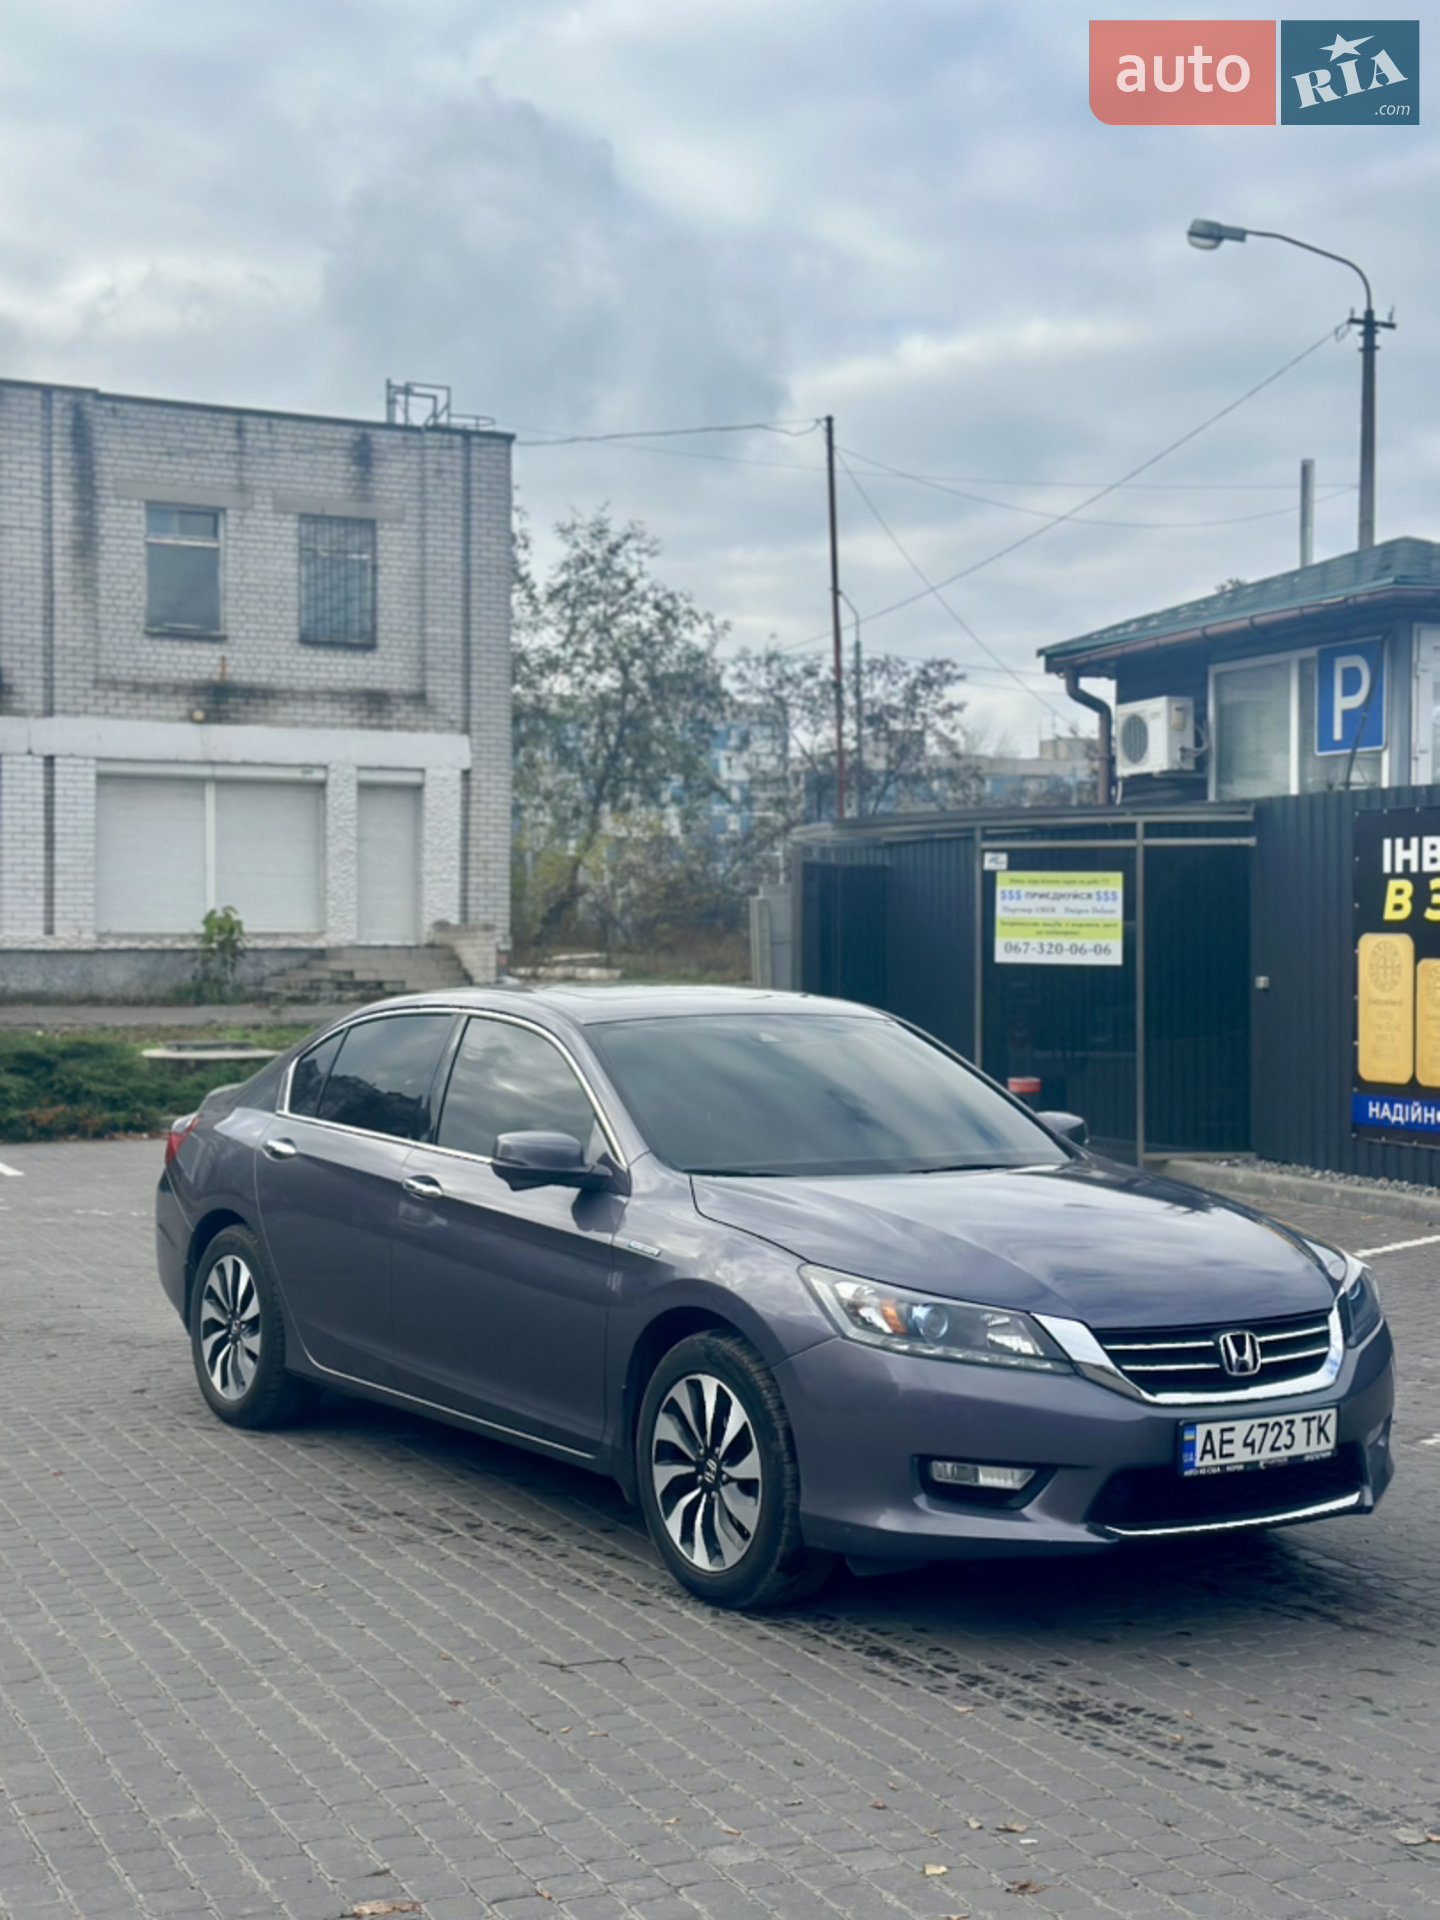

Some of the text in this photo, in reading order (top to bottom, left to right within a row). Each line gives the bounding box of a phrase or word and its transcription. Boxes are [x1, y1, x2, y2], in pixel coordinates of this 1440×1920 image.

[1333, 654, 1371, 742] P
[1383, 879, 1413, 920] В
[1004, 942, 1112, 956] 067-320-06-06
[1199, 1413, 1333, 1461] AE 4723 TK
